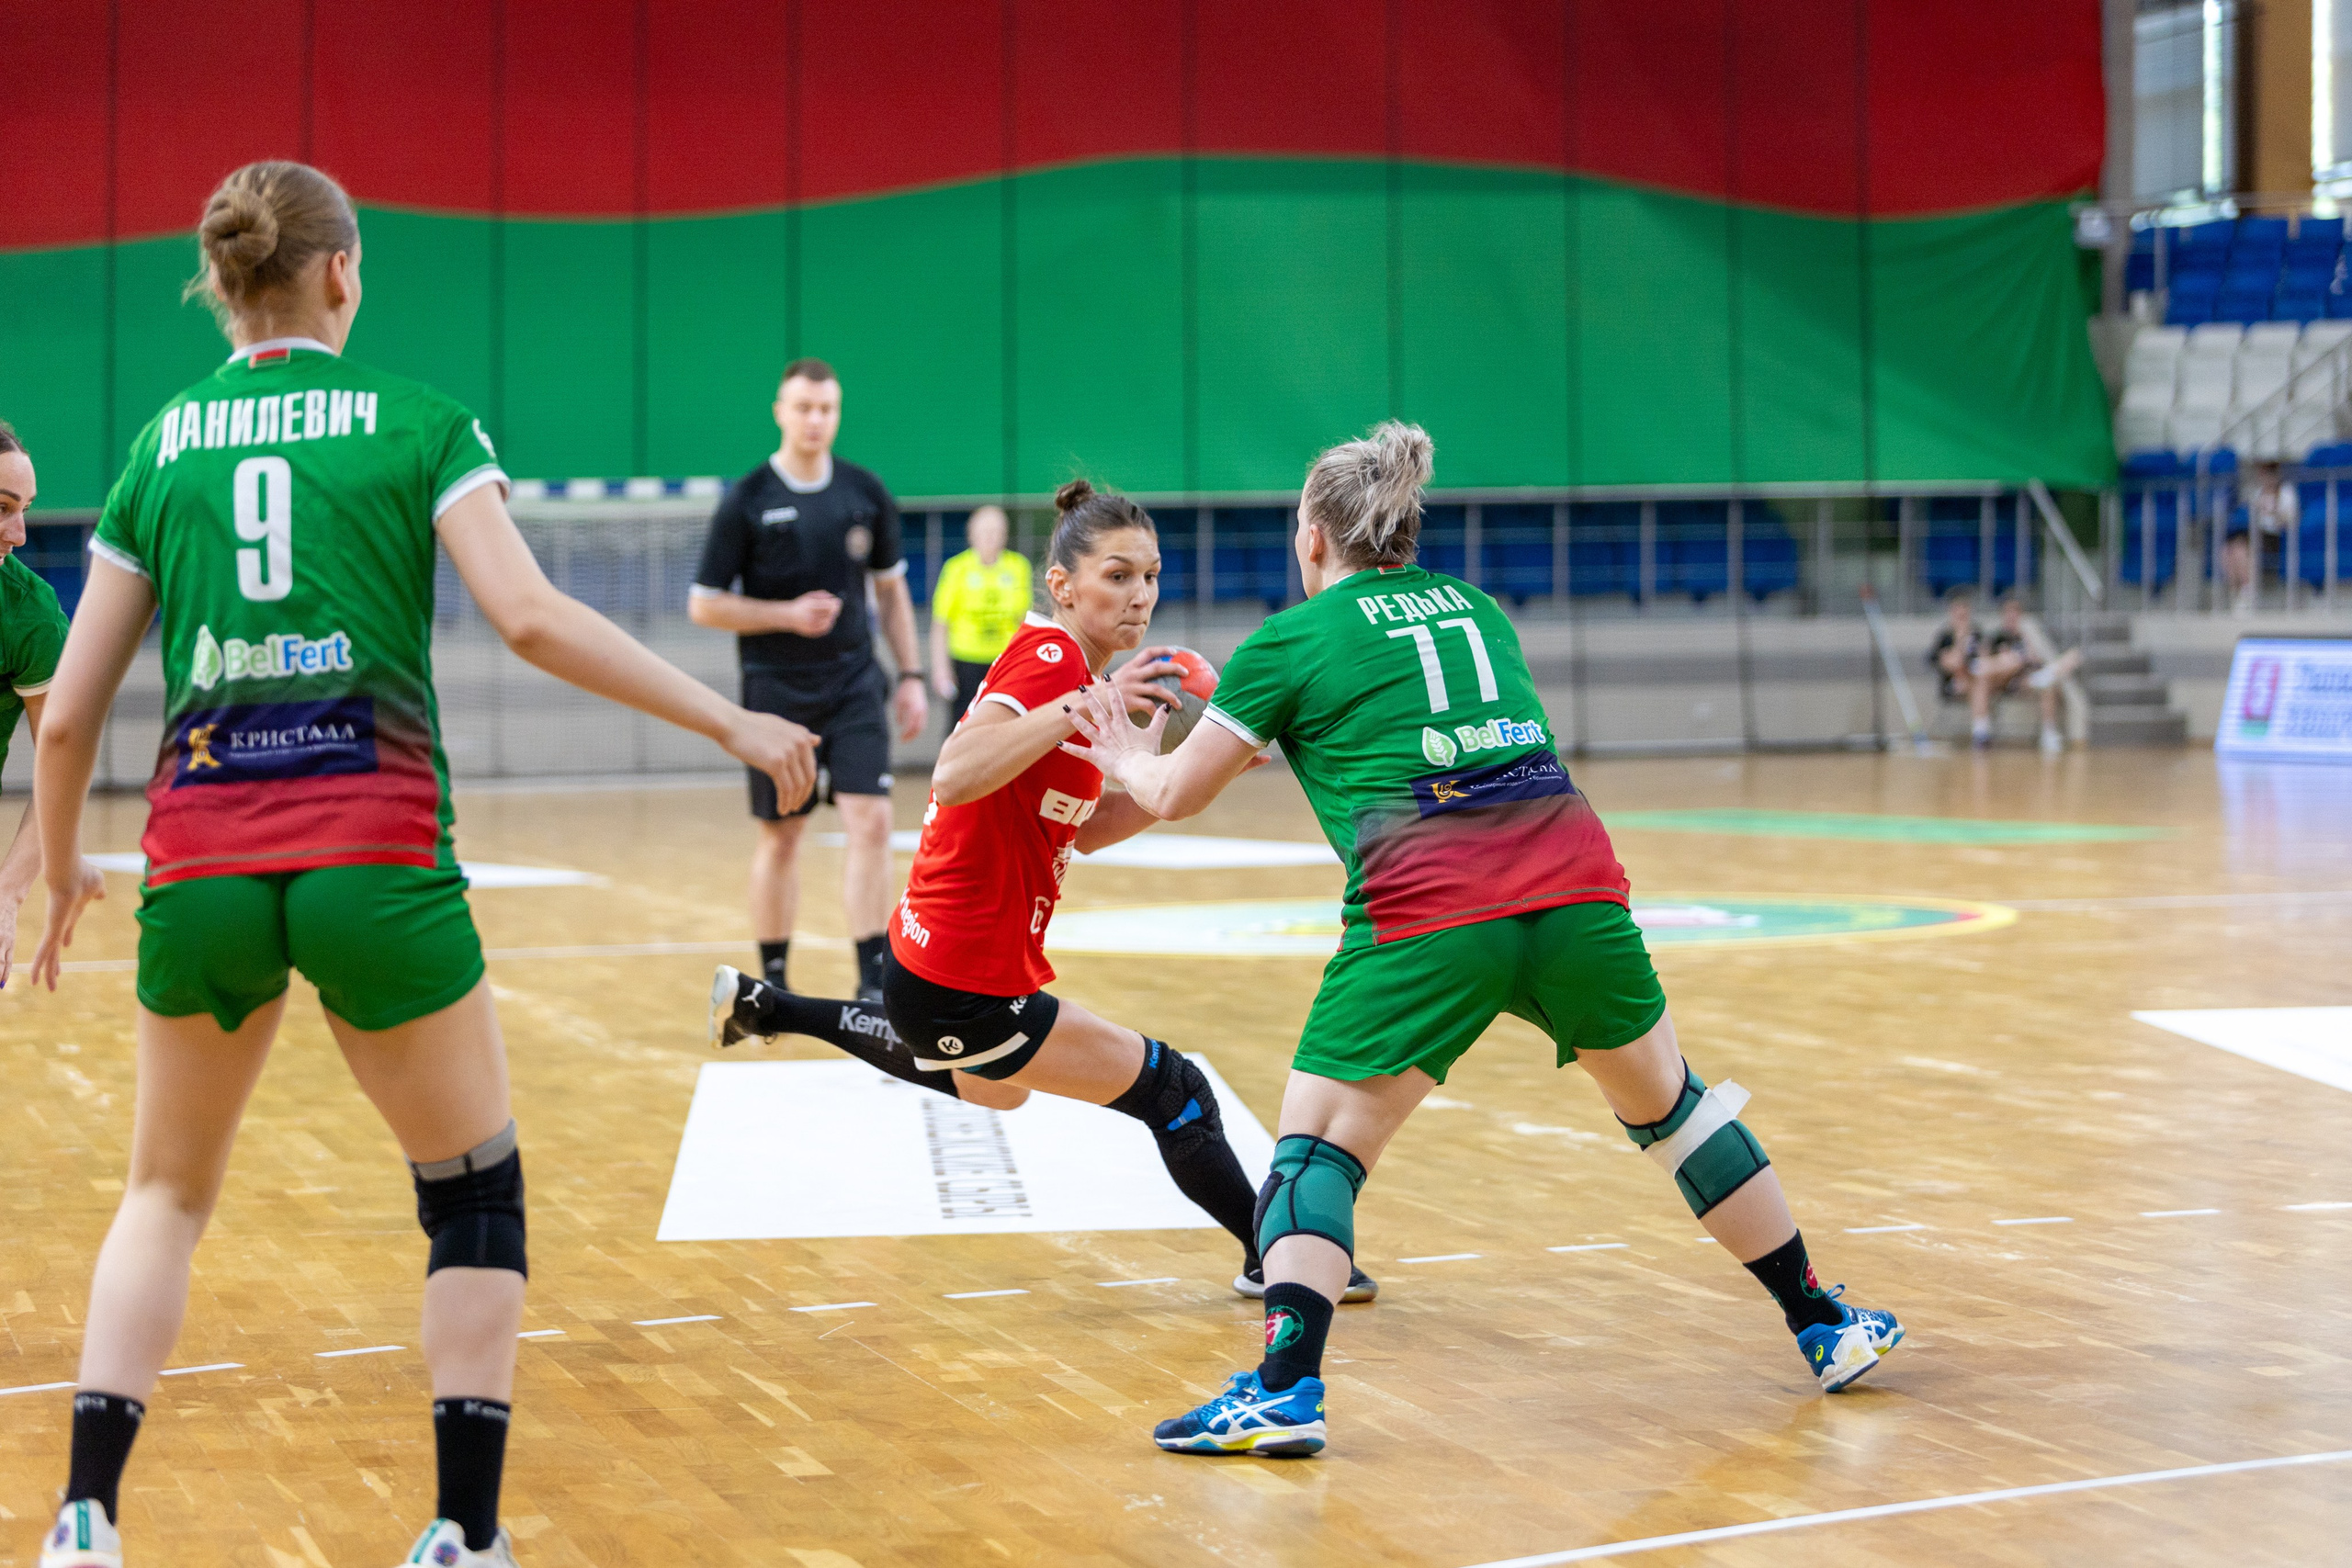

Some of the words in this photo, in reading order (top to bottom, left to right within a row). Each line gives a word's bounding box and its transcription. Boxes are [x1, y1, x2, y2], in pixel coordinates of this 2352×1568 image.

[157, 389, 378, 468] ДАНИЛЕВИЧ
[232, 456, 293, 602] 9
[1356, 585, 1475, 625] РЕДЬКА
[227, 634, 350, 678] BelFert
[1385, 617, 1499, 714] 77
[1457, 720, 1545, 750] BelFert
